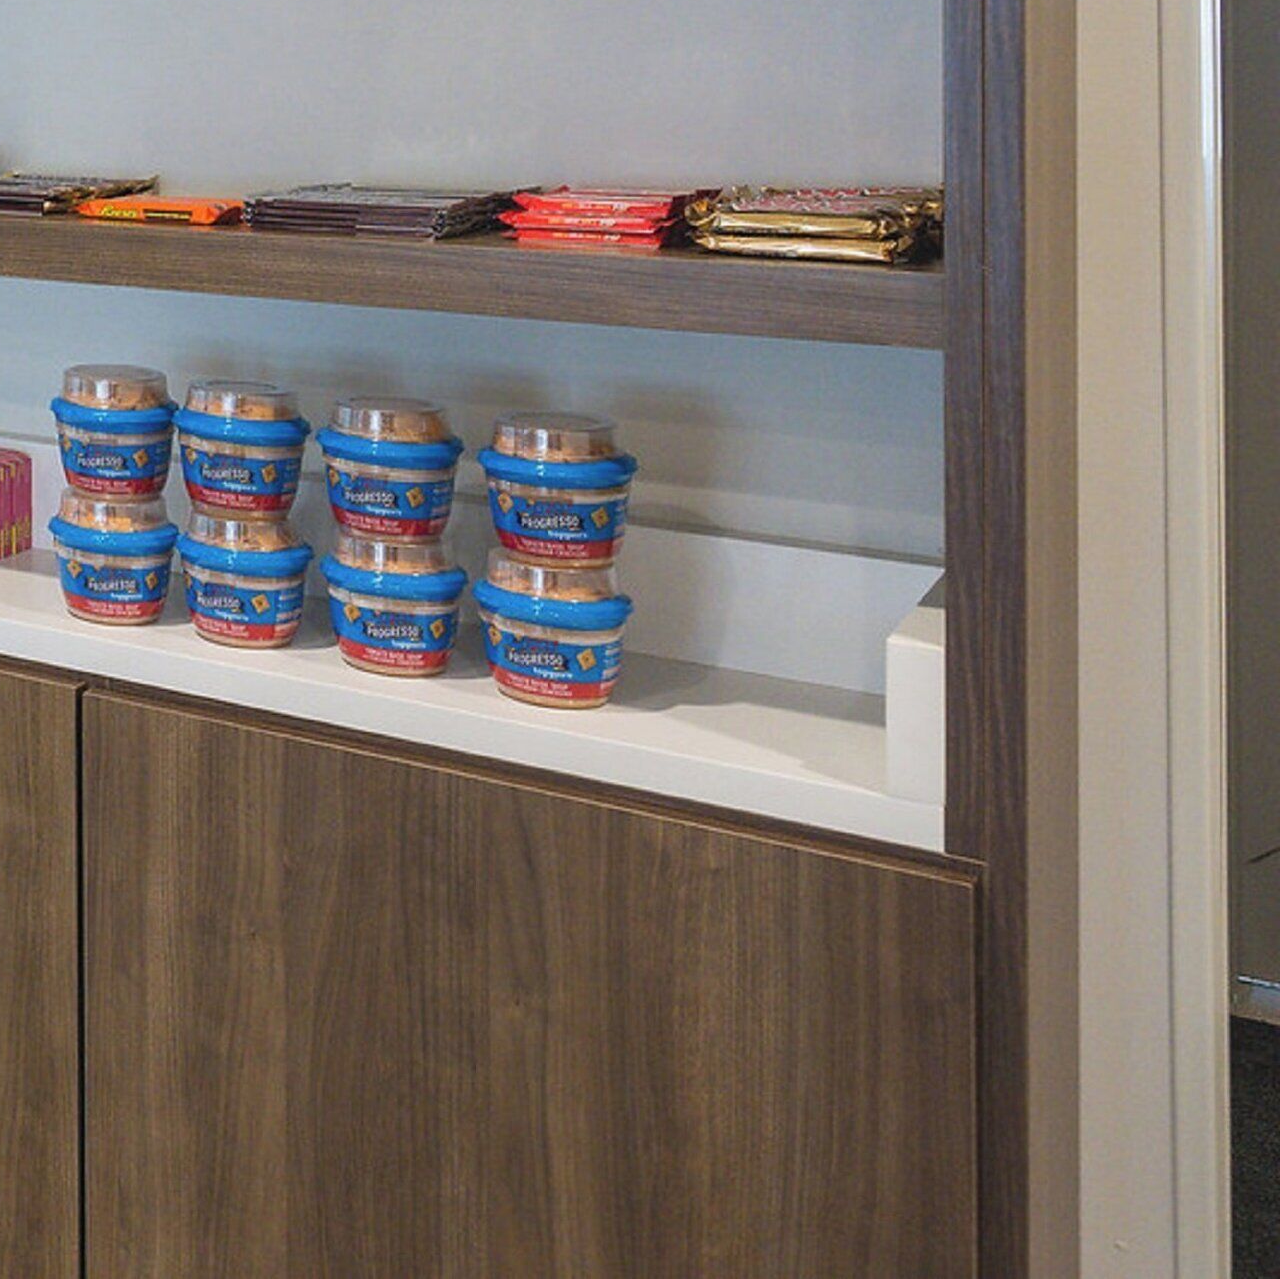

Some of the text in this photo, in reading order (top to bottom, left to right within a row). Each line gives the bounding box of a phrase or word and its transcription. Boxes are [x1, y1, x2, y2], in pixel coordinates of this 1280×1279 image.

[77, 454, 125, 469] PROGRESSO
[202, 465, 251, 483] PROGRESSO
[345, 490, 396, 508] PROGRESSO
[521, 512, 580, 531] PROGRESSO
[88, 579, 138, 594] PROGRESSO
[197, 592, 242, 613] PROGRESSO
[366, 623, 422, 640] PROGRESSO
[508, 649, 566, 671] PROGRESSO
